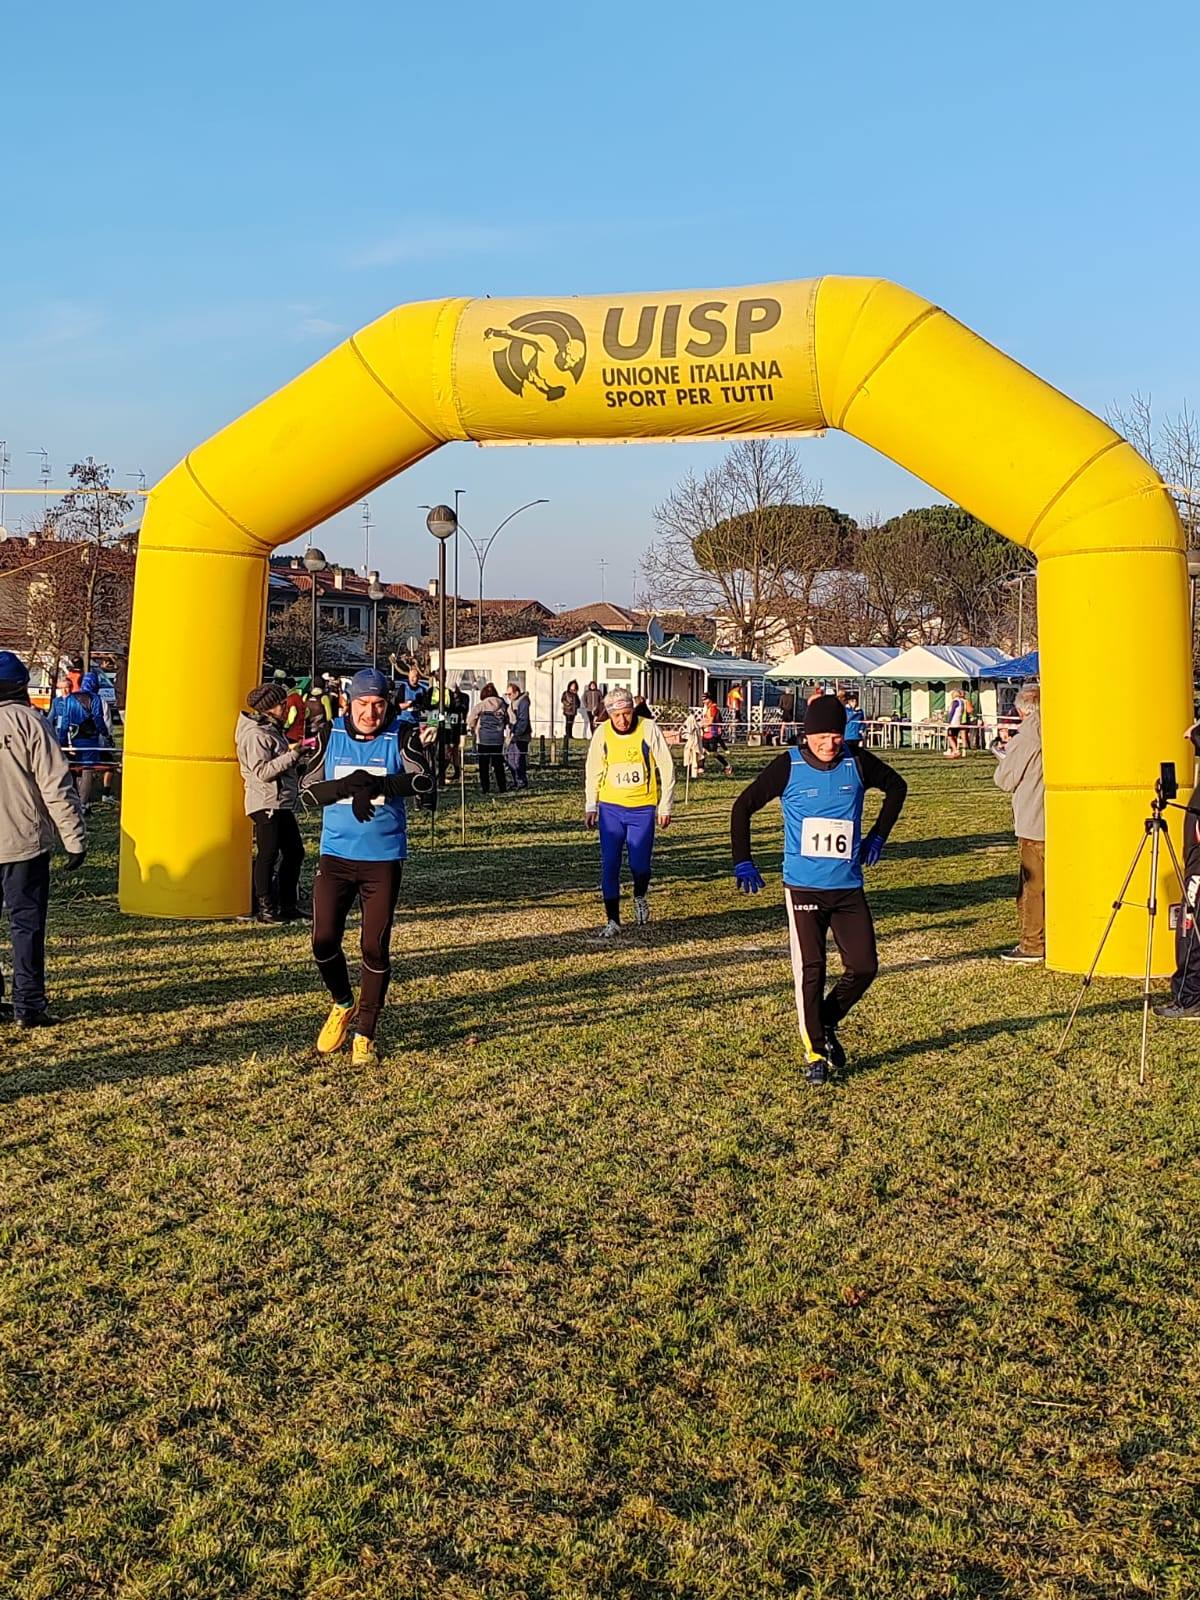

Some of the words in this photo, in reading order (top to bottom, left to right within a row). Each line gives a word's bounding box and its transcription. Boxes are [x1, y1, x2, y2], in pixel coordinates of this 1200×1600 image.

[602, 299, 782, 360] UISP
[602, 365, 680, 387] UNIONE
[690, 360, 782, 382] ITALIANA
[605, 389, 667, 408] SPORT
[677, 386, 712, 405] PER
[720, 384, 773, 403] TUTTI
[615, 770, 640, 784] 148
[811, 833, 847, 853] 116
